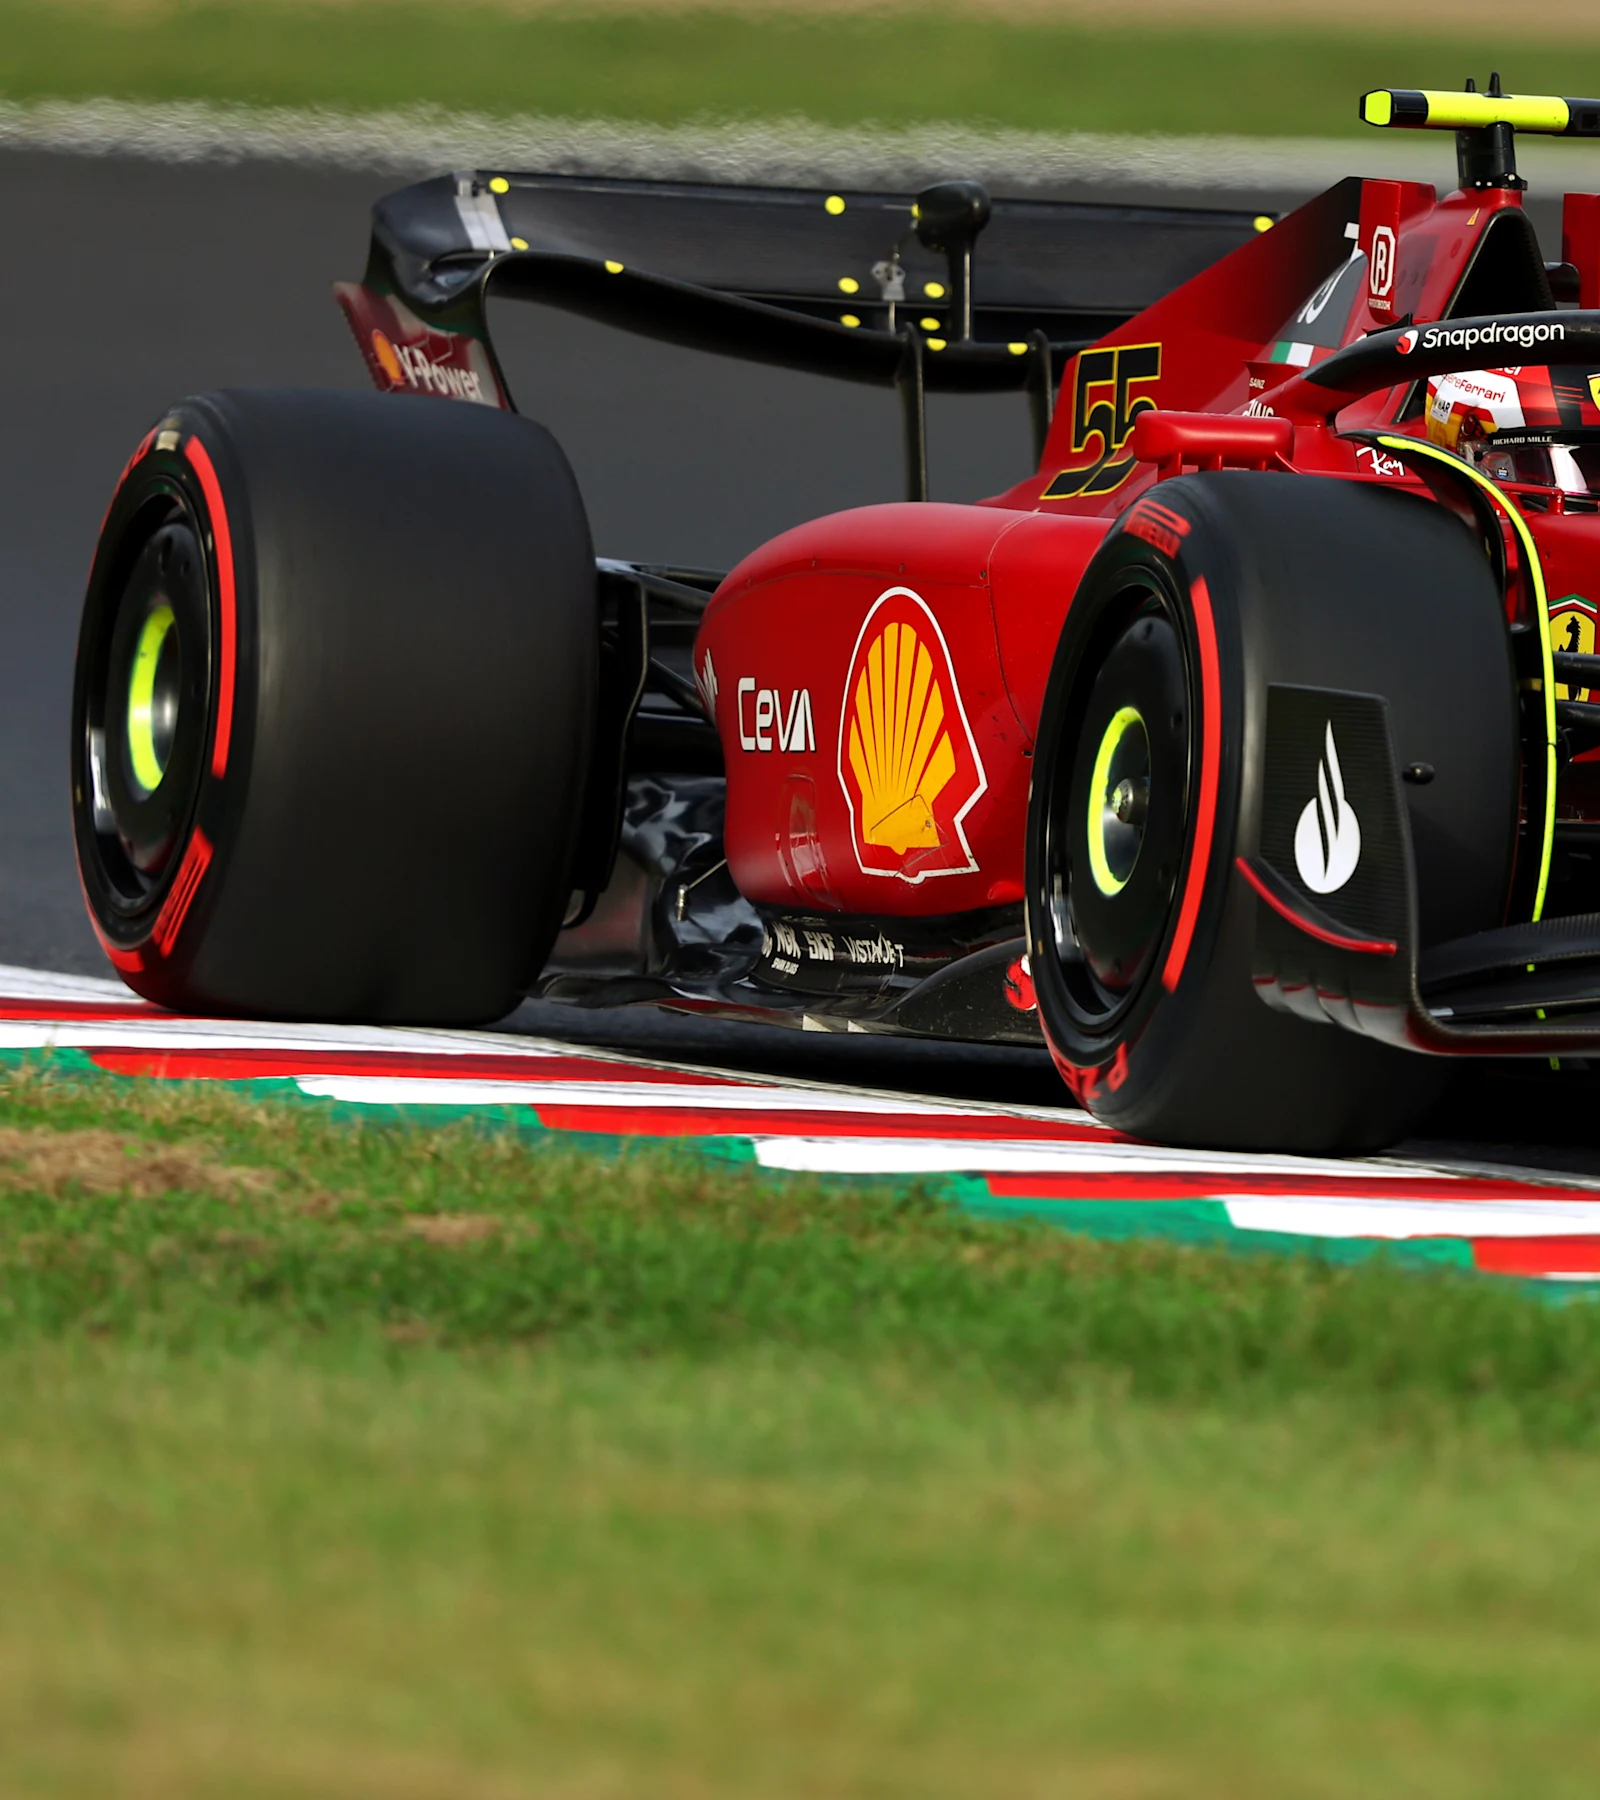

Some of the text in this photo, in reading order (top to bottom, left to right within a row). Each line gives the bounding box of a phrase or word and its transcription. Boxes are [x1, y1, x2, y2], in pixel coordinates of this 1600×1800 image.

[1422, 322, 1565, 351] Snapdragon
[394, 343, 484, 401] V-Power
[1249, 377, 1266, 390] SAINZ
[1039, 341, 1163, 500] 55
[1492, 435, 1552, 446] RICHARD MILLE
[1356, 446, 1405, 476] Ray
[772, 920, 801, 960] NGK
[803, 930, 836, 962] SKF
[841, 930, 905, 969] VISTAJET
